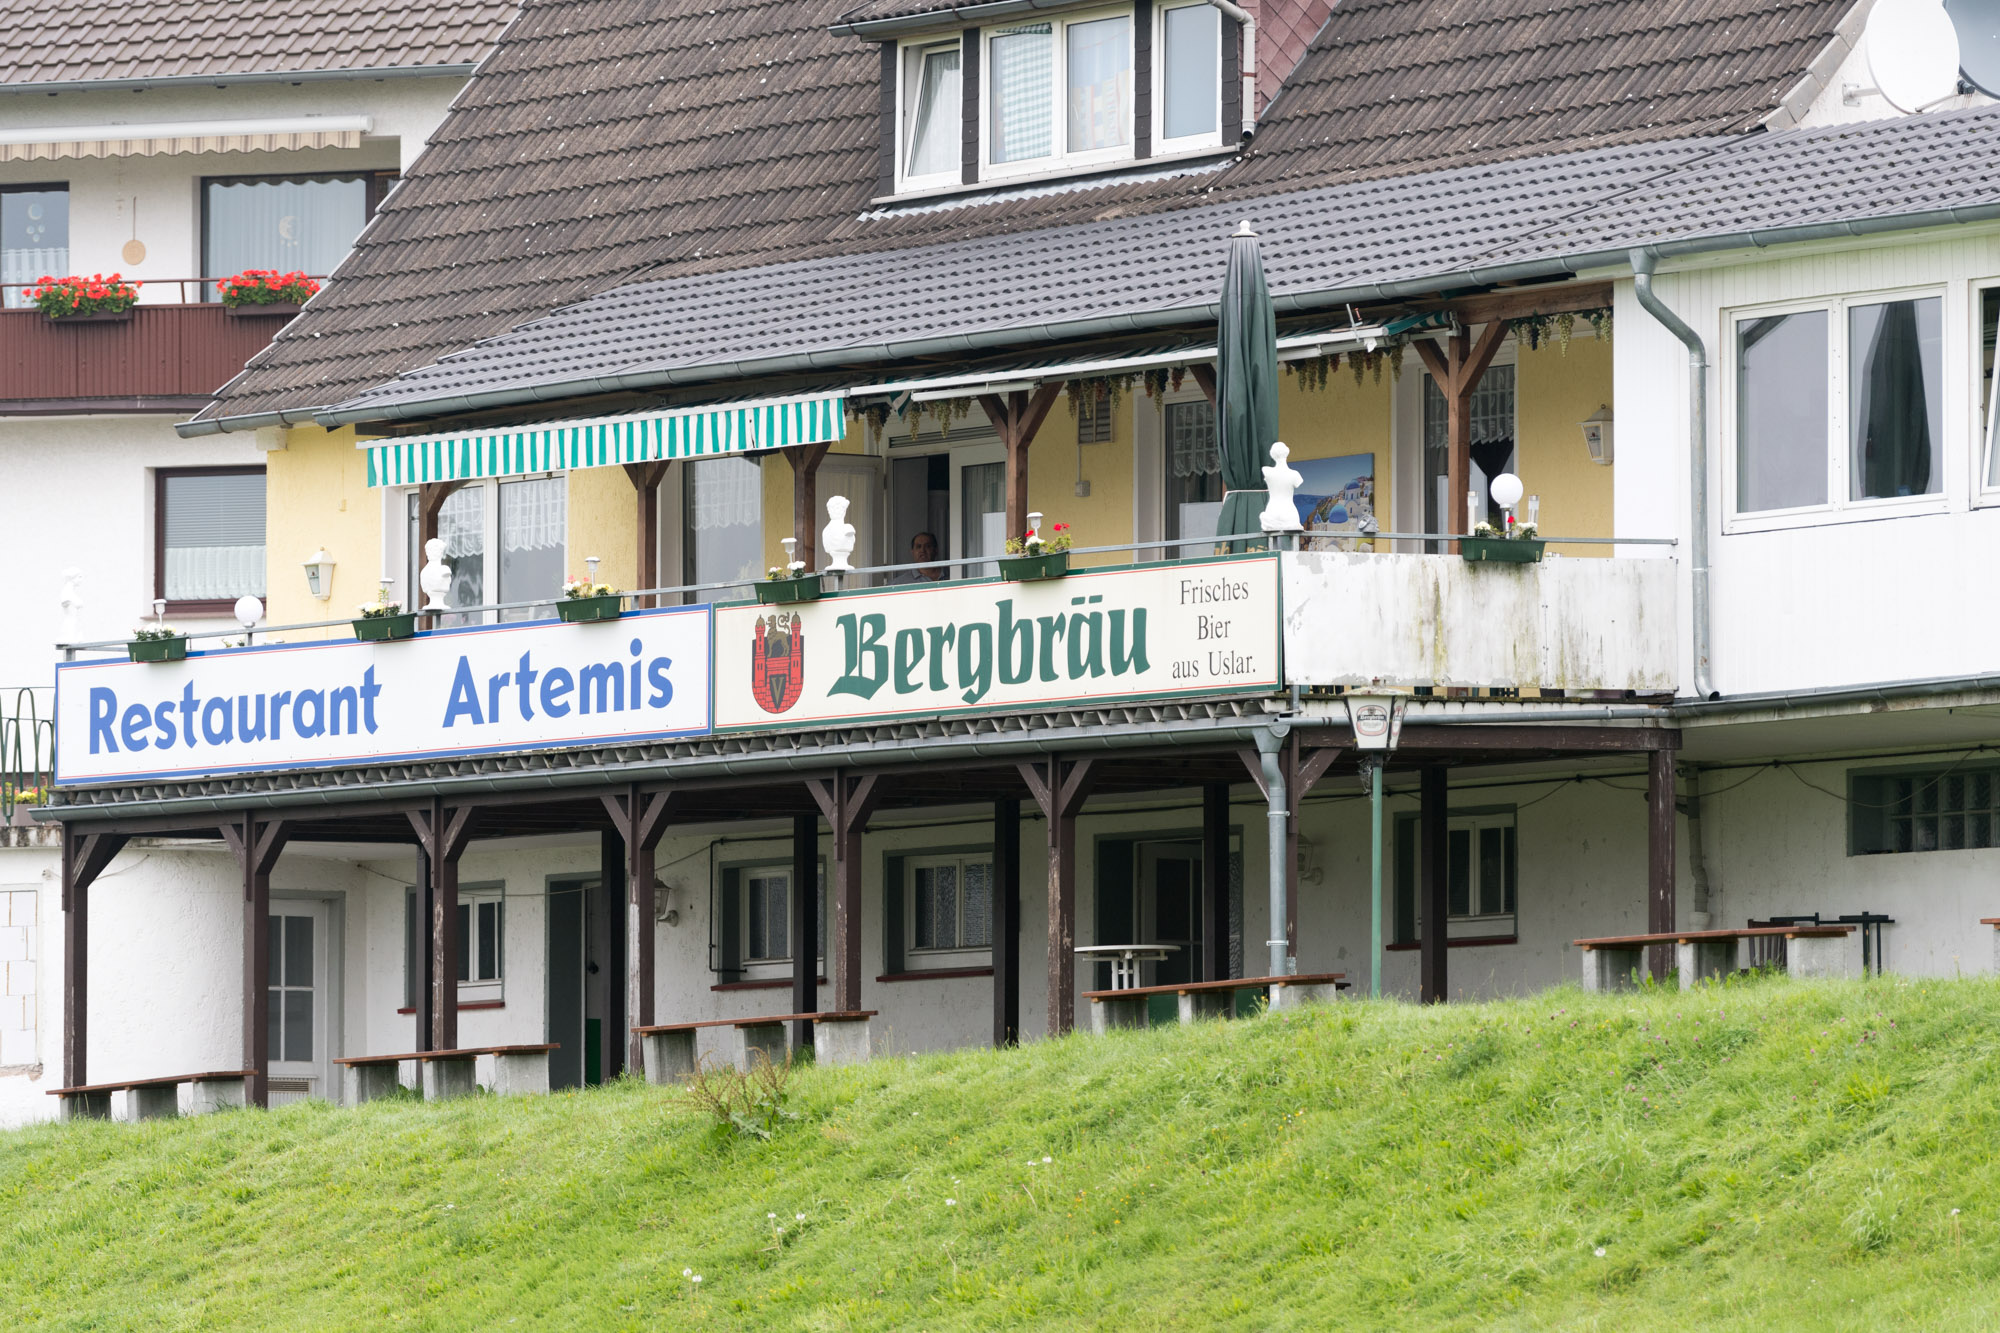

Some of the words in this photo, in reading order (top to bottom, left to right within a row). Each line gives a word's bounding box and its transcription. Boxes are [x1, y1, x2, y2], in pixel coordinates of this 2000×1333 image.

[1180, 577, 1249, 605] Frisches
[1197, 614, 1231, 640] Bier
[826, 594, 1151, 705] Bergbräu
[1171, 658, 1199, 679] aus
[1208, 649, 1257, 677] Uslar.
[89, 664, 382, 755] Restaurant
[442, 637, 674, 728] Artemis
